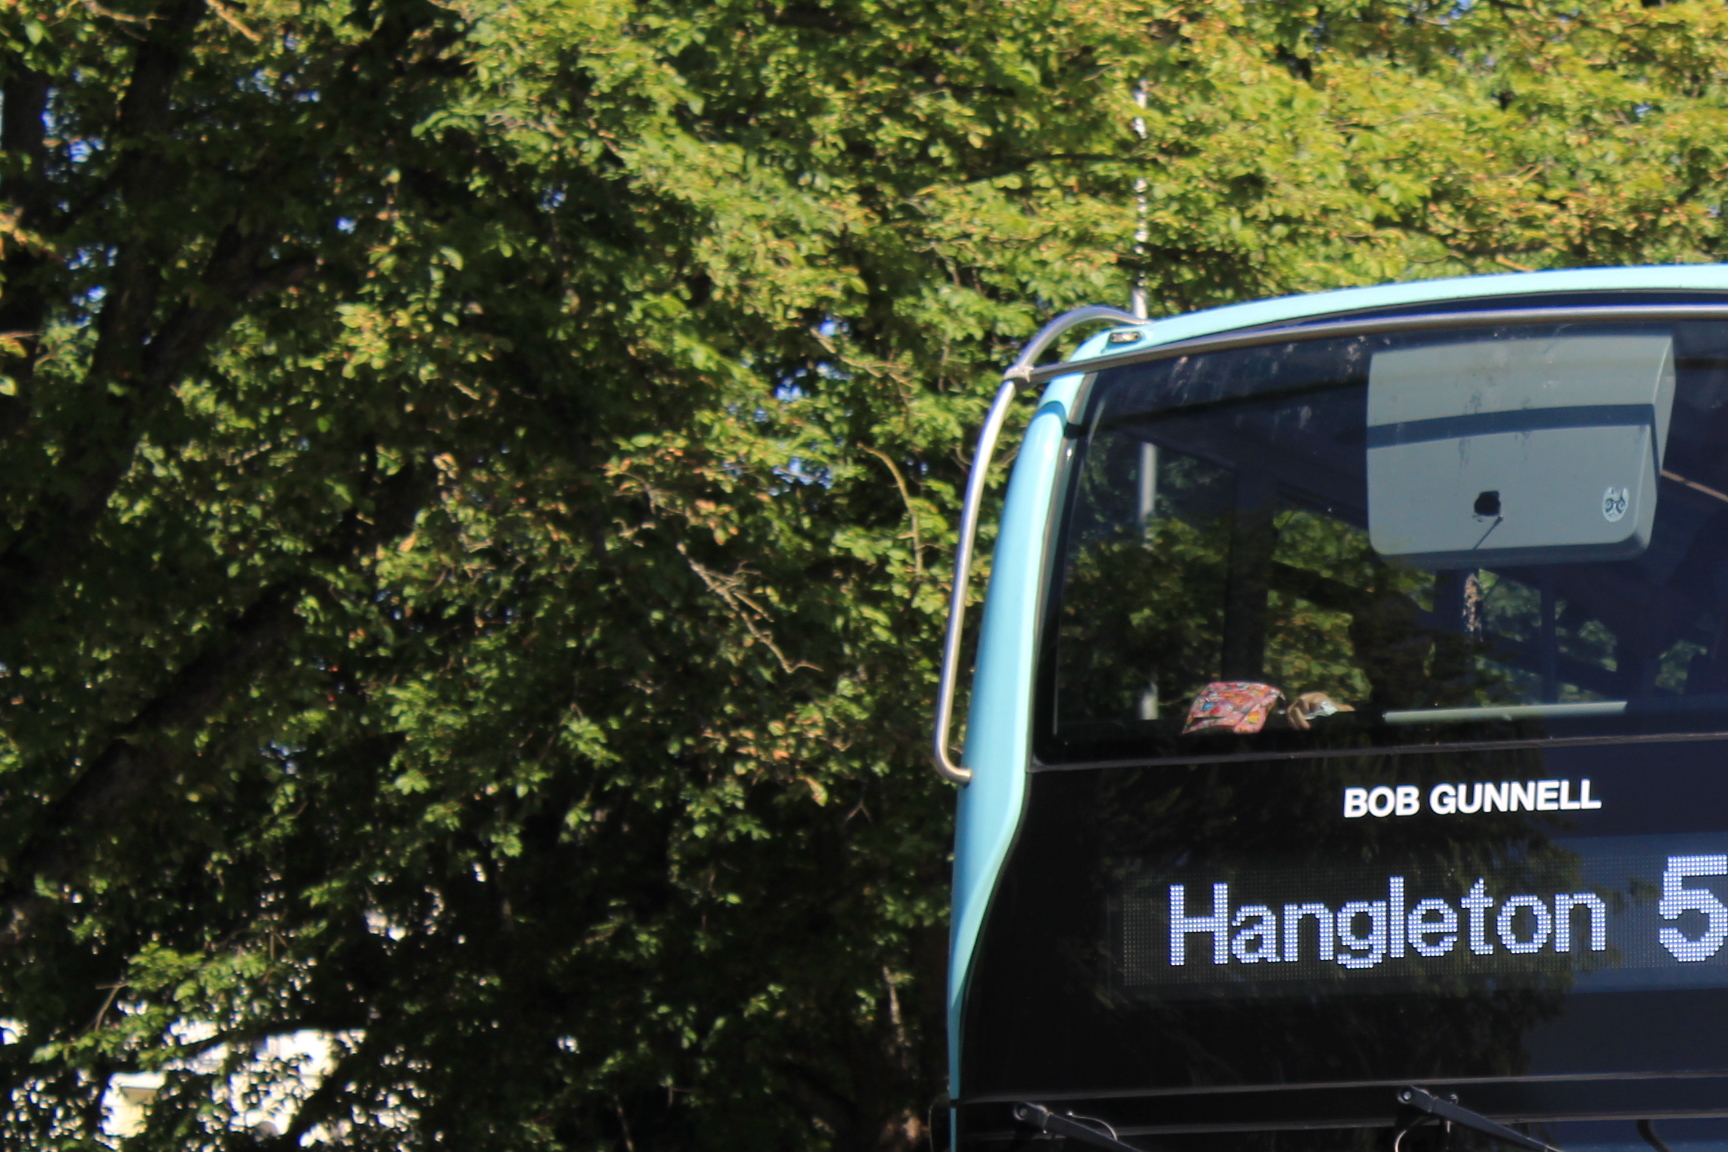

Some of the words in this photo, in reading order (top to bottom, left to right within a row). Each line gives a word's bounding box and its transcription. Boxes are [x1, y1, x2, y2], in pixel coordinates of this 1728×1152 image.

[1343, 784, 1421, 818] BOB
[1429, 780, 1602, 815] GUNNELL
[1168, 876, 1606, 970] Hangleton
